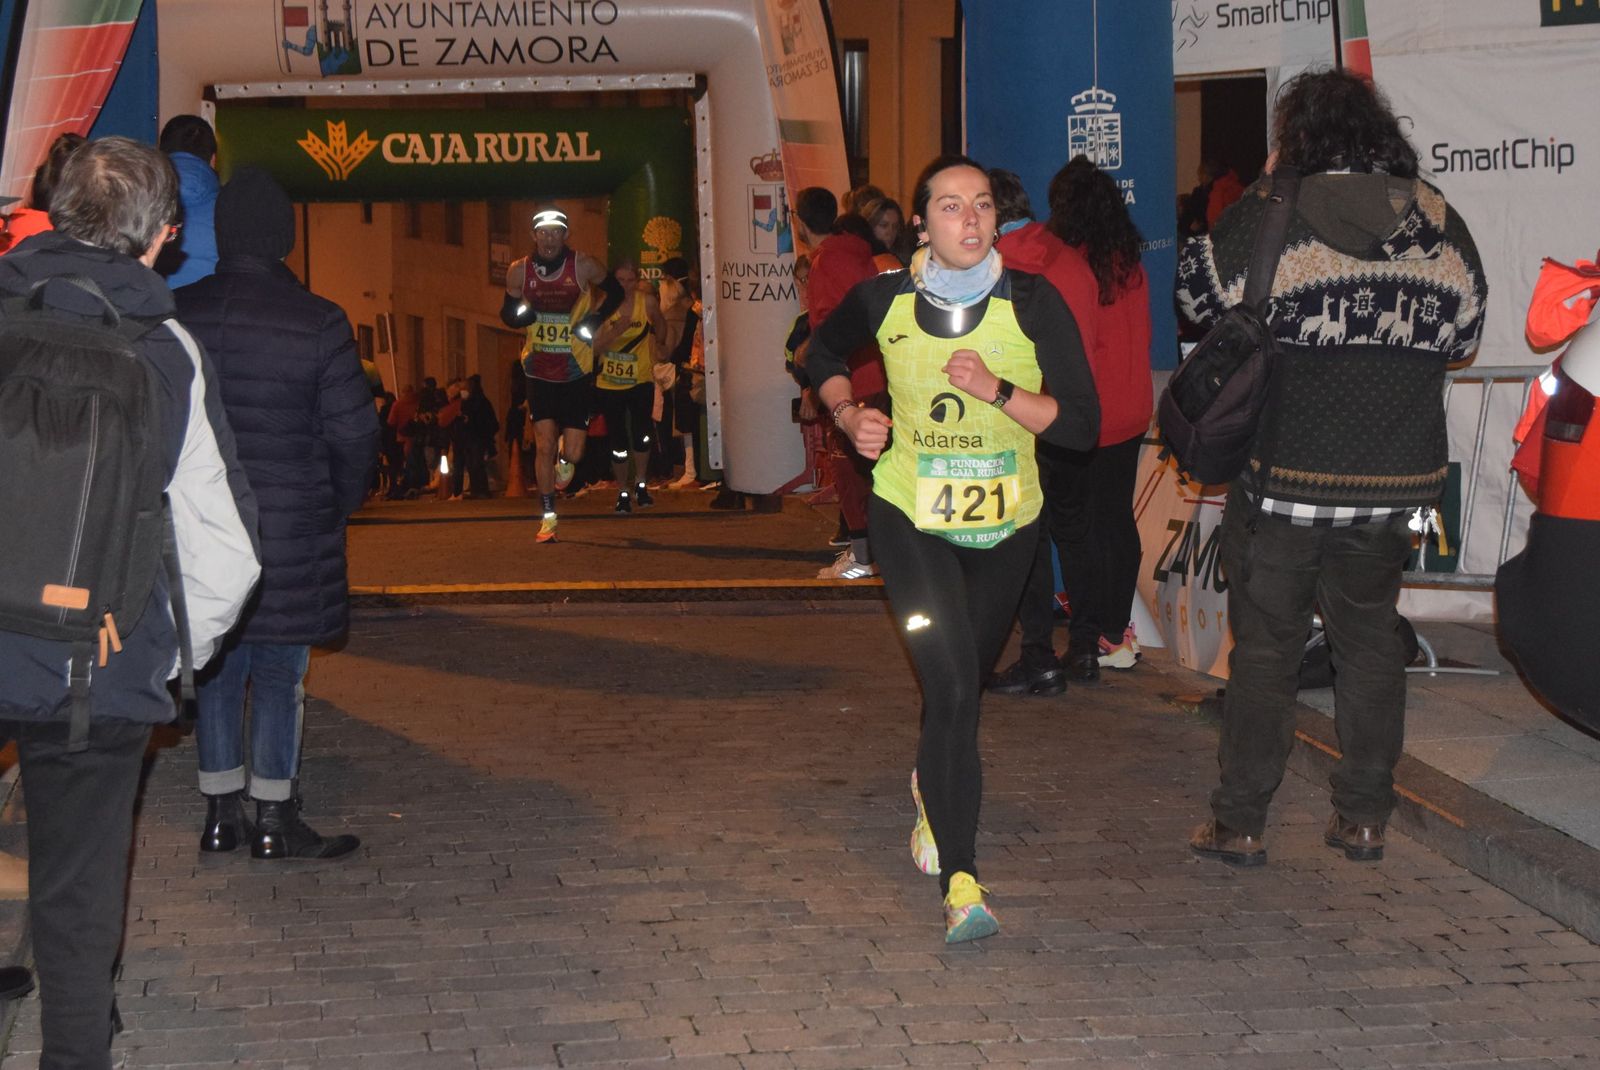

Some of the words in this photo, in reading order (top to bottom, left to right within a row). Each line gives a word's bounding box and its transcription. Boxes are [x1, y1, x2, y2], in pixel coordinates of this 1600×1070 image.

[365, 0, 619, 29] AYUNTAMIENTO
[1216, 0, 1332, 29] SmartChip
[366, 38, 419, 67] DE
[435, 35, 619, 66] ZAMORA
[382, 132, 472, 166] CAJA
[474, 132, 601, 163] RURAL
[1431, 136, 1575, 173] SmartChip
[722, 280, 741, 301] DE
[535, 325, 571, 343] 494
[606, 361, 634, 377] 554
[913, 430, 983, 449] Adarsa
[931, 482, 1005, 523] 421
